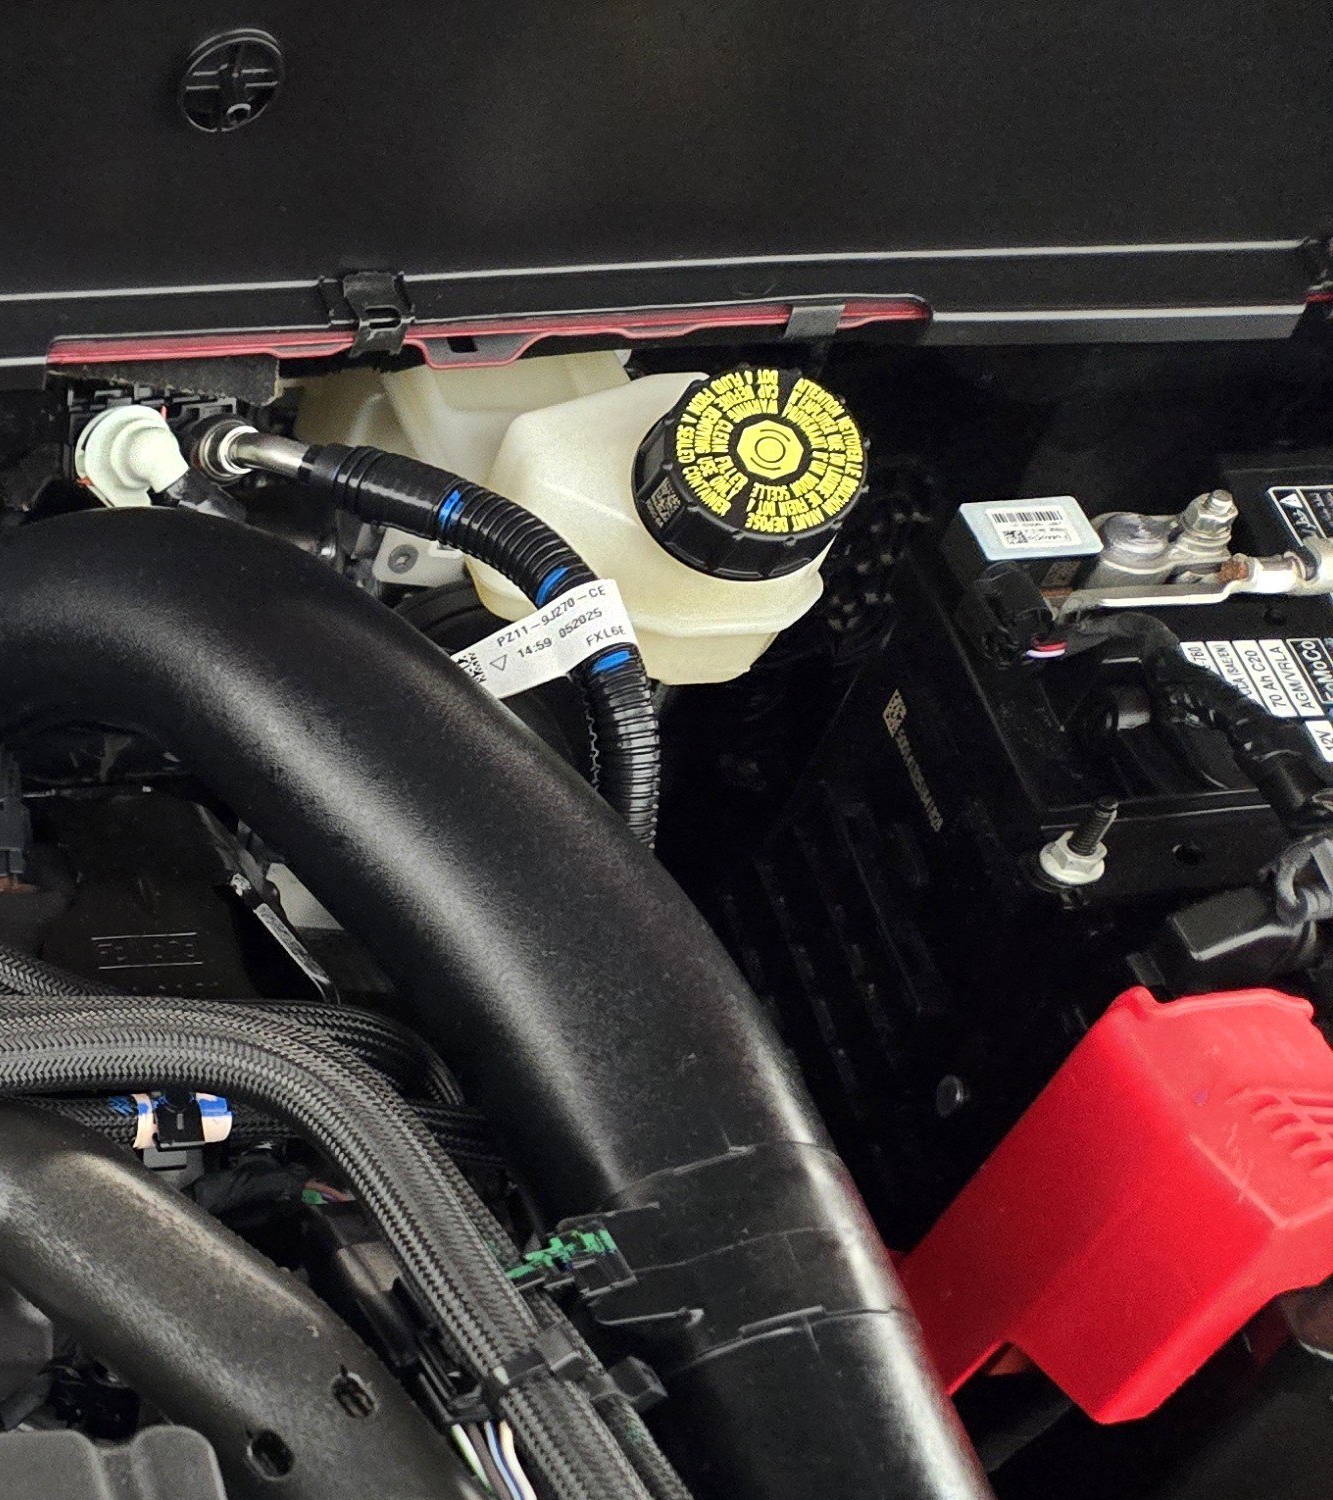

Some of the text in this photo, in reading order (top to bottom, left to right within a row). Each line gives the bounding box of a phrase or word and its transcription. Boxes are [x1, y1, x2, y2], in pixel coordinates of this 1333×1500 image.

[727, 398, 778, 423] WARNING
[781, 403, 827, 449] PROVENANT
[676, 369, 778, 516] DOT 4 FLUID FROM A SEALED CONTAINER
[691, 383, 779, 504] CAP BEFORE REMOVING USE ONLY
[709, 419, 734, 453] CLEAN
[741, 378, 863, 533] ATTENTION NETTOYER LE BOUCHON AVANT DEPOSE
[750, 482, 790, 502] SCELLE
[753, 500, 777, 517] DOT
[804, 490, 823, 508] DE
[517, 607, 603, 658] 14:59 052025
[1245, 650, 1287, 707] 70 Ah C20
[1269, 646, 1315, 709] AGM/VRLA
